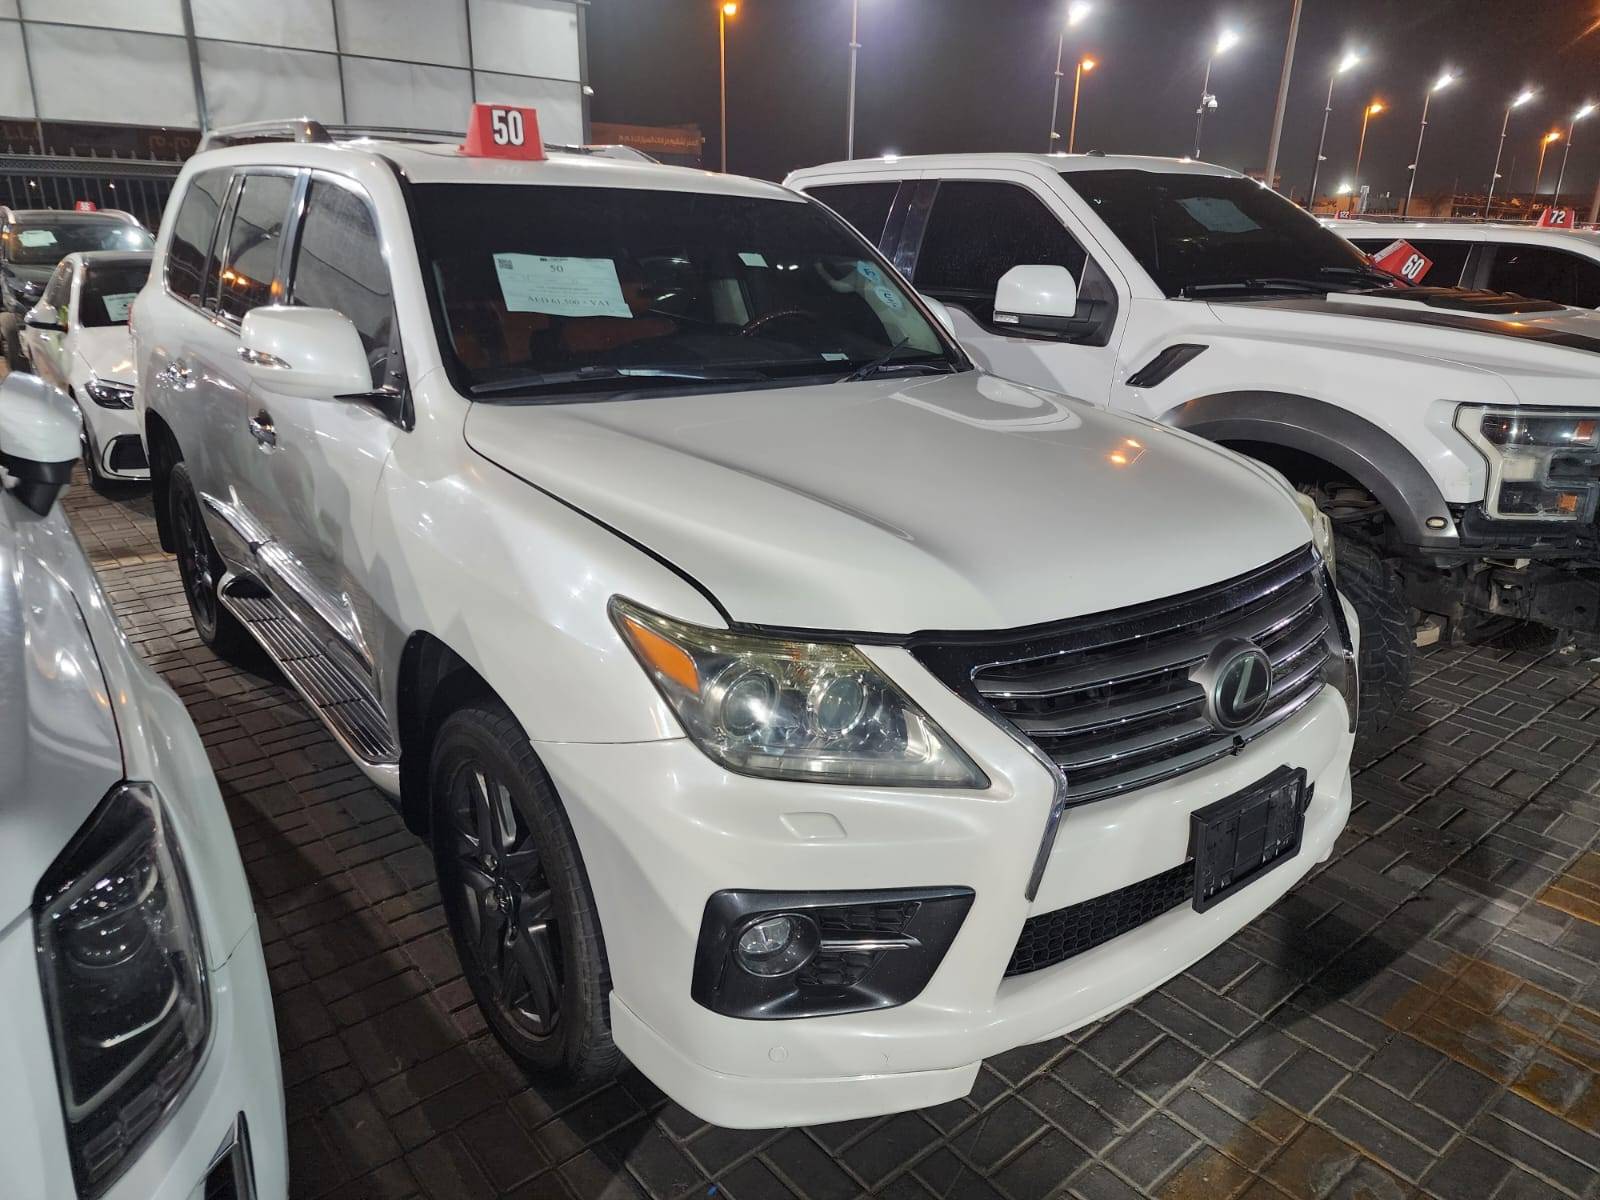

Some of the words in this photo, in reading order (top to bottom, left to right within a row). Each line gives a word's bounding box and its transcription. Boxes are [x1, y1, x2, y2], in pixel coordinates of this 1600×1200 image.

[491, 108, 524, 146] 50
[1550, 209, 1566, 224] 72
[549, 264, 564, 273] 50
[1401, 253, 1425, 280] 60
